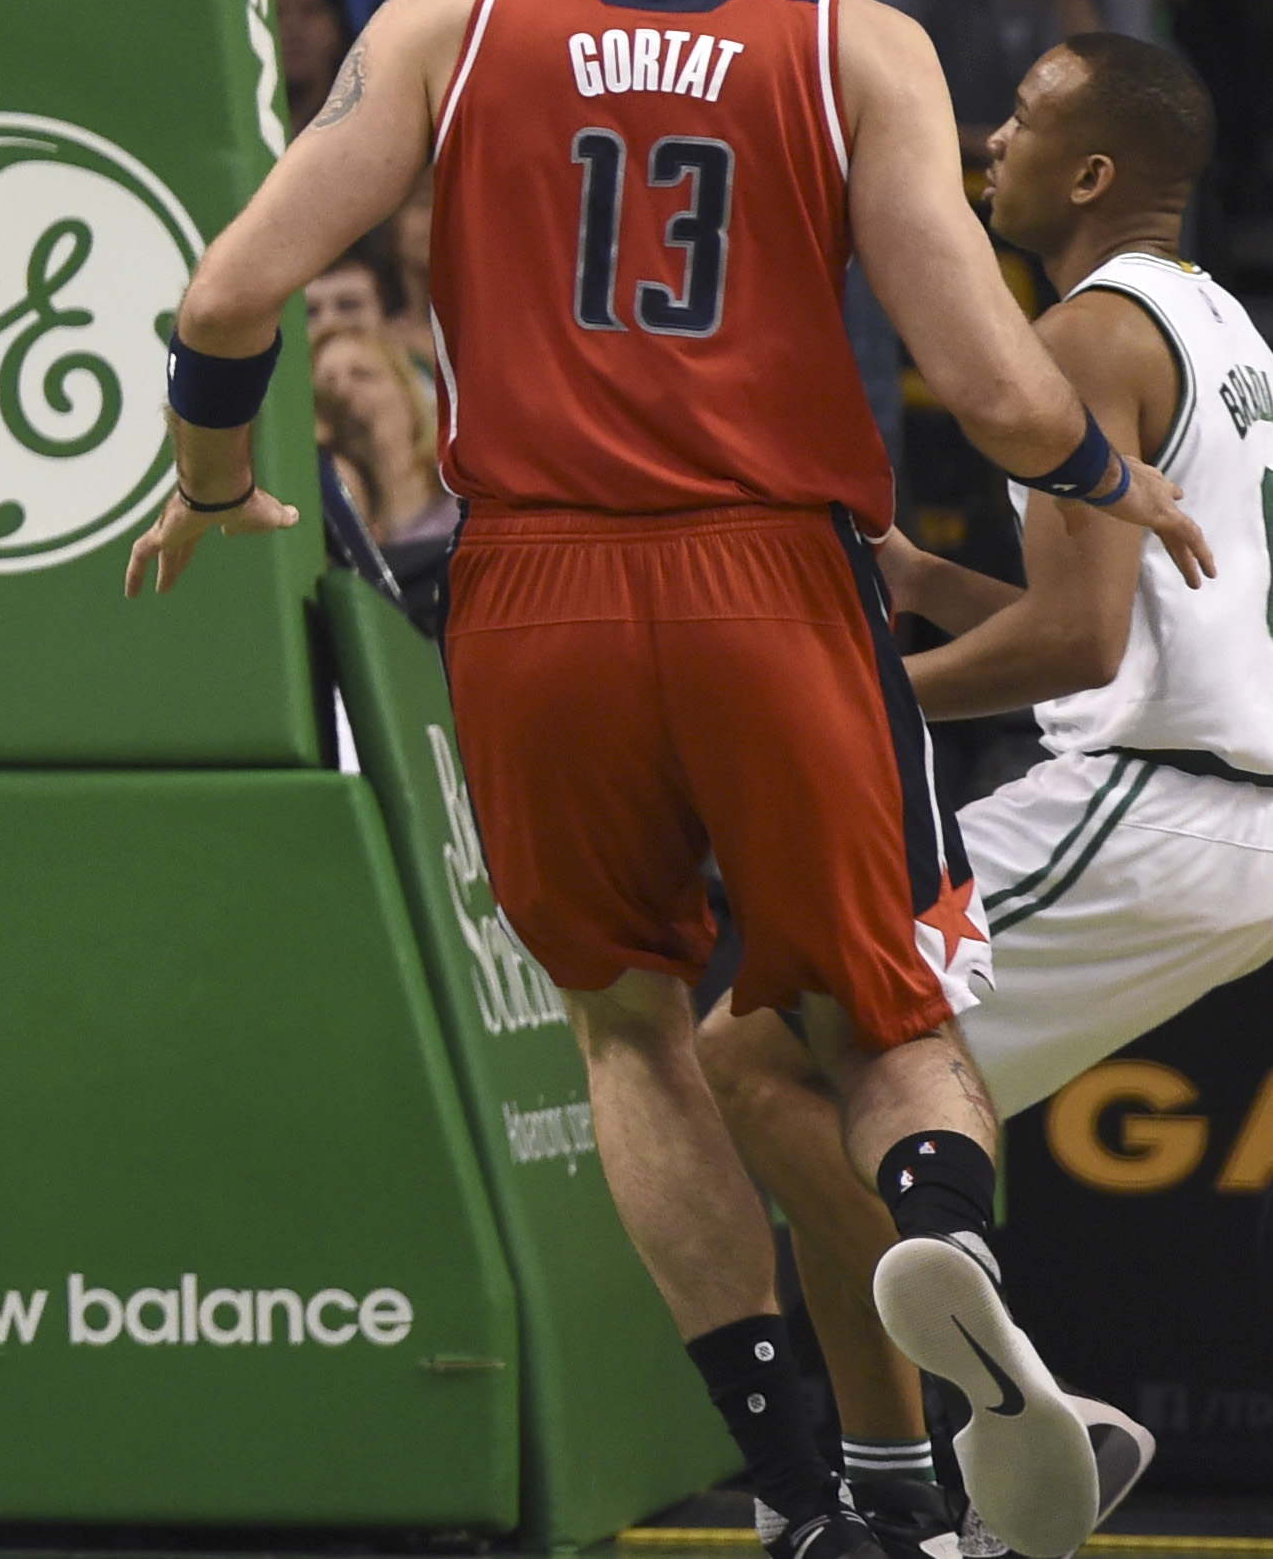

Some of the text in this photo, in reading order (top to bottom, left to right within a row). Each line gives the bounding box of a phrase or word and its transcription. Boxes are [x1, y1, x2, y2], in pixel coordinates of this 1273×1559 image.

[568, 28, 744, 102] GORTAT
[571, 127, 736, 338] 13
[66, 1272, 415, 1347] balance
